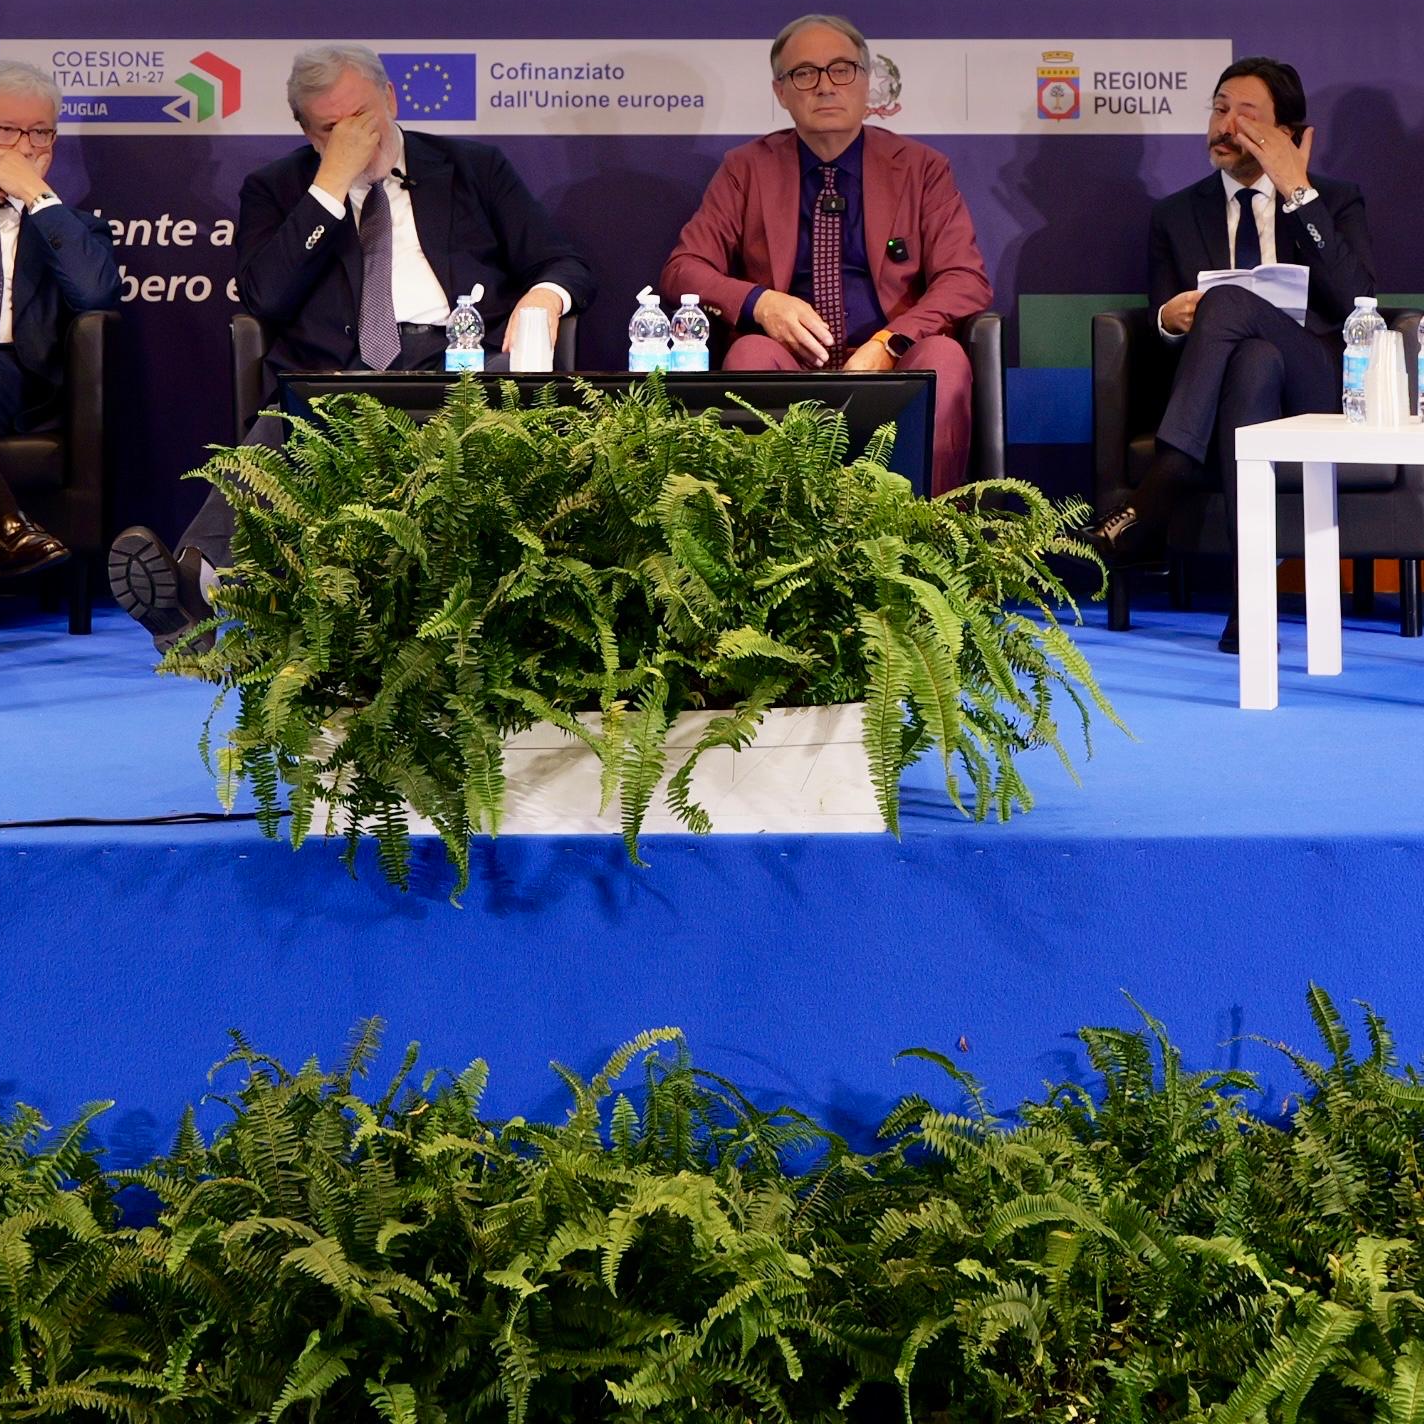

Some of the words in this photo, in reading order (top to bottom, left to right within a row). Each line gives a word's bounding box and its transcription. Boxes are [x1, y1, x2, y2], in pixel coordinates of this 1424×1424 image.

[52, 51, 164, 67] COESIONE
[53, 71, 120, 87] ITALIA
[126, 71, 164, 84] 21-27
[489, 61, 624, 82] Cofinanziato
[1092, 70, 1188, 91] REGIONE
[59, 103, 108, 116] PUGLIA
[489, 87, 610, 110] dall'Unione
[617, 91, 705, 114] europea
[1093, 96, 1172, 116] PUGLIA
[93, 209, 197, 246] ente
